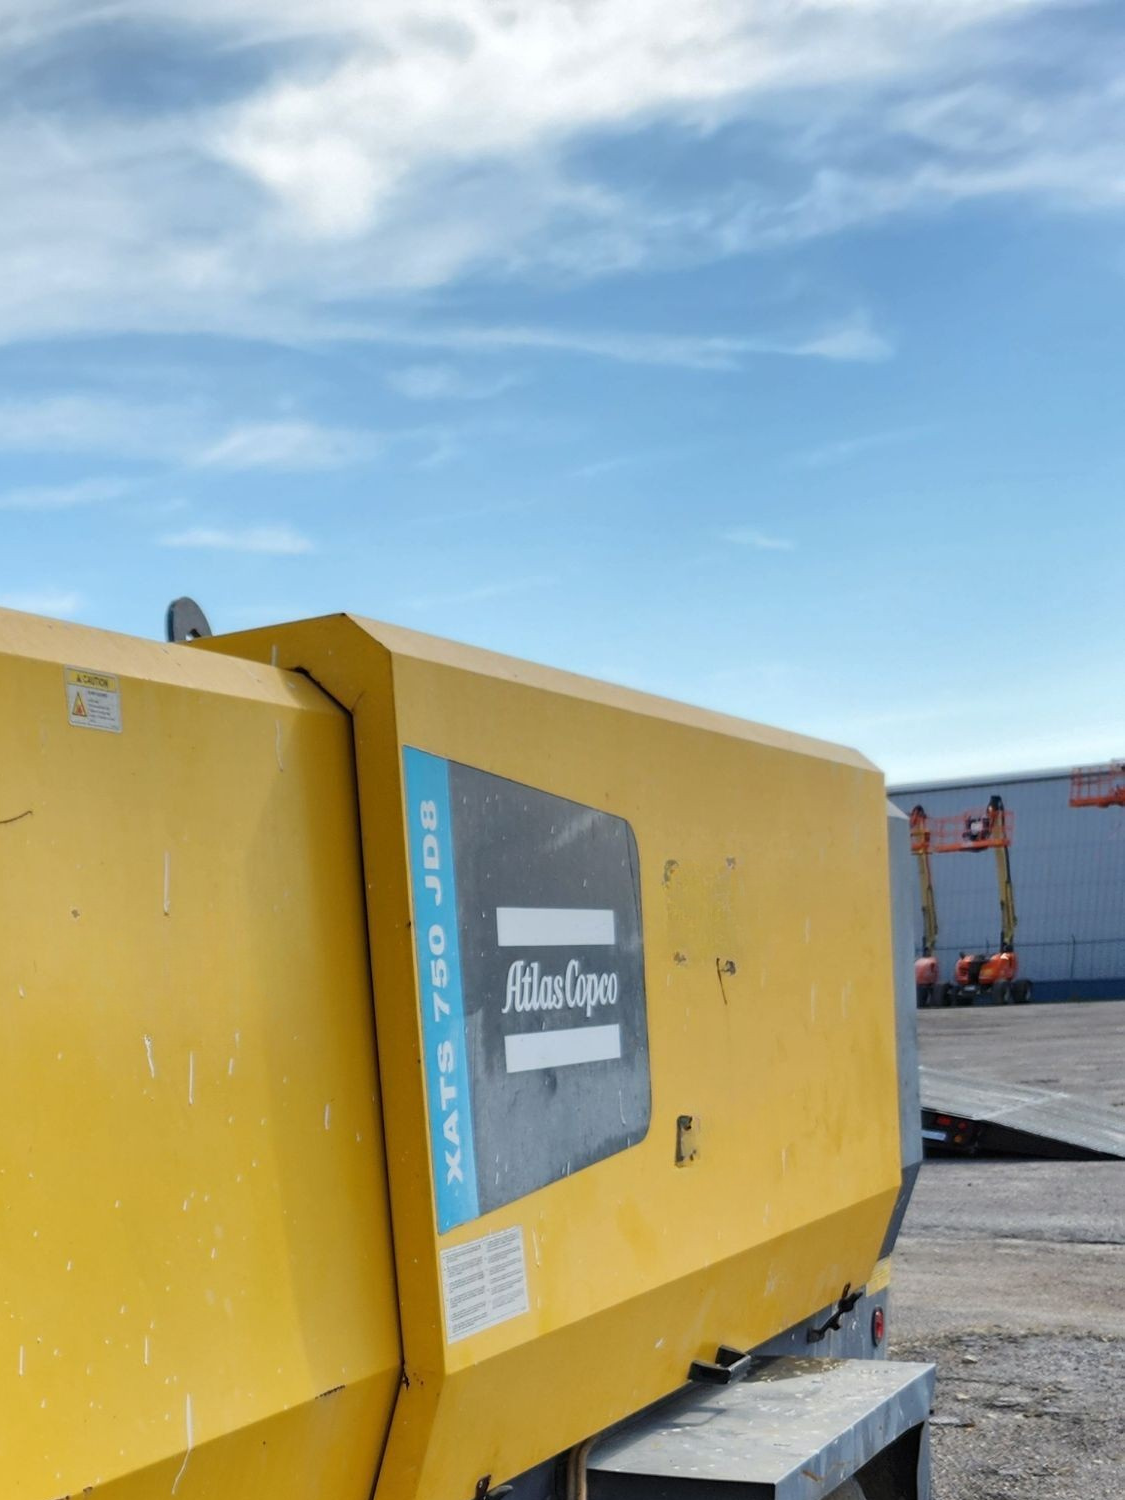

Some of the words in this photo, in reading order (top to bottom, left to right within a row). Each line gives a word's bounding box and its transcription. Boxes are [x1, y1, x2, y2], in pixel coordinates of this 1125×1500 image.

[420, 800, 443, 907] JD8
[429, 924, 451, 1022] 750
[501, 959, 564, 1014] Atlas
[565, 958, 618, 1017] Copco
[438, 1039, 465, 1187] XATS
